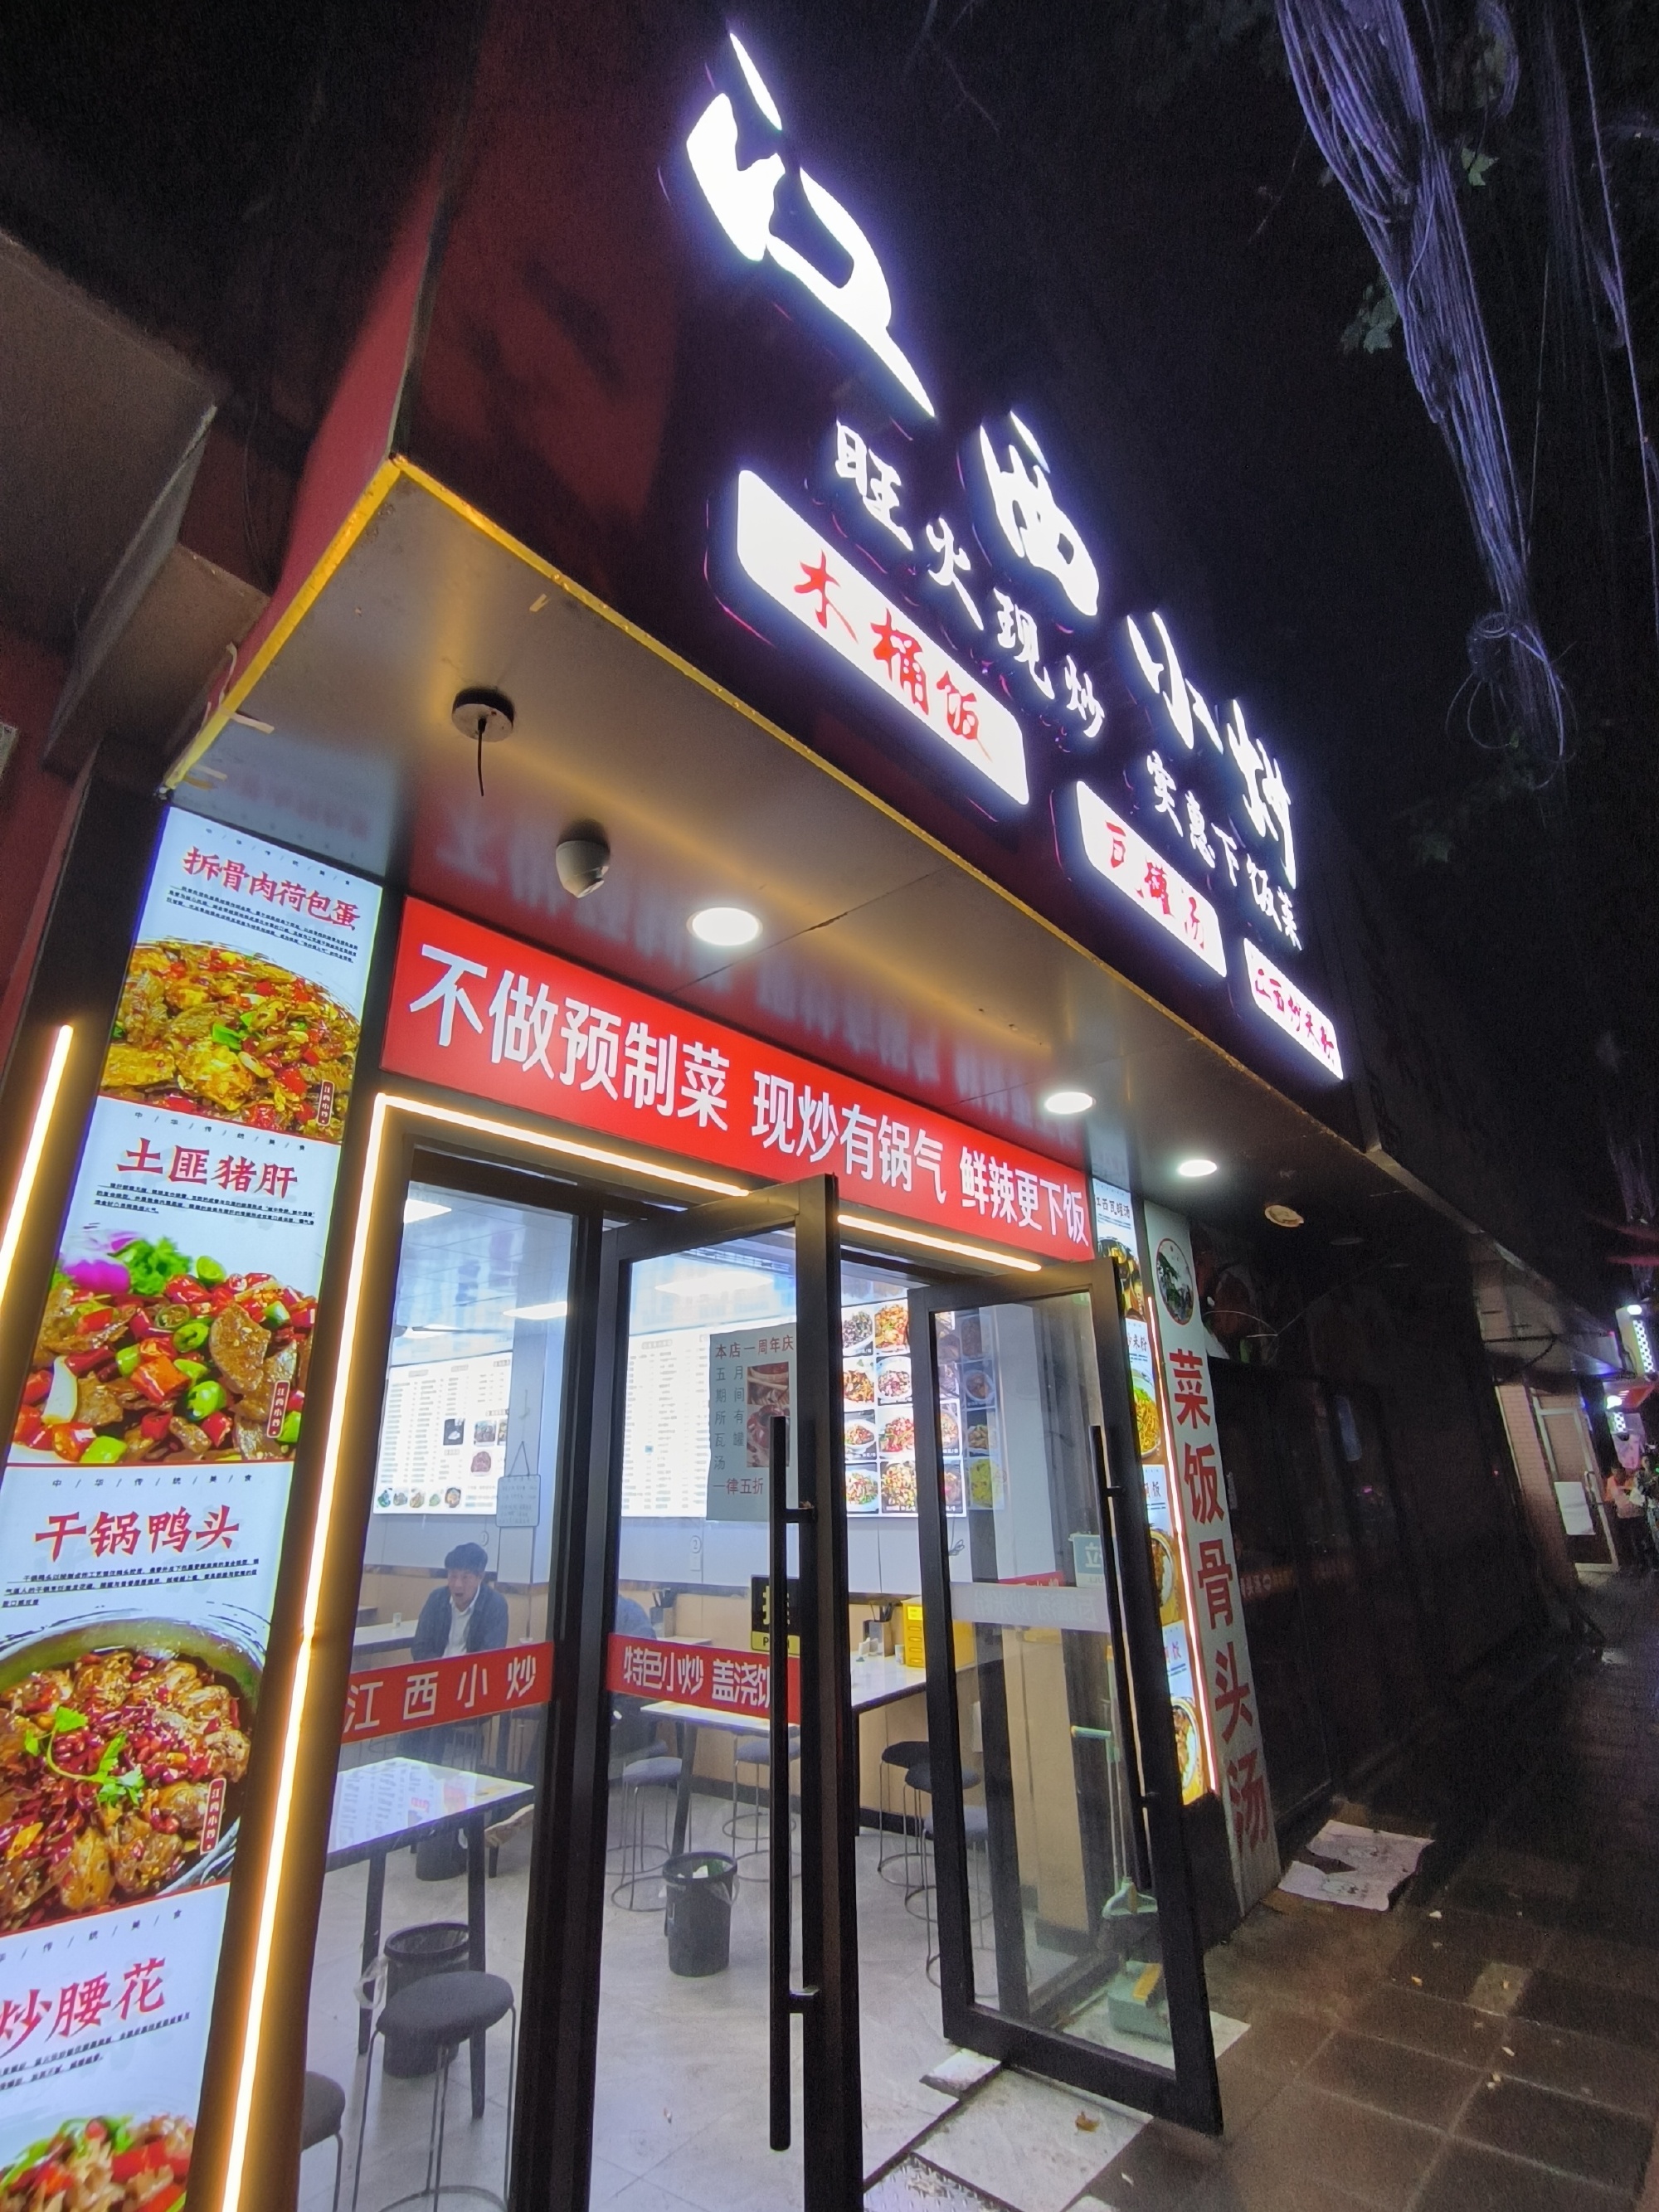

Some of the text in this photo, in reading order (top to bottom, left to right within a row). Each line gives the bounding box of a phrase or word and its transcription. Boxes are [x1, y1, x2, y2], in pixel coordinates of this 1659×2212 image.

[686, 33, 1296, 889] 江西小炒
[834, 420, 1107, 738] 旺火现炒
[794, 550, 993, 762] 木桶饭
[182, 846, 361, 931] 拆骨肉荷包蛋
[1146, 751, 1303, 950] 实惠下饭菜
[410, 944, 1089, 1247] 不做预制菜 现炒有锅气 鲜辣更下饭
[116, 1137, 298, 1199] 土匪猪肝
[715, 1334, 794, 1359] 本店一周年庆
[713, 1478, 763, 1495] 一律五折
[35, 1505, 240, 1563] 干锅鸭头
[343, 1655, 536, 1733] 江西小炒
[624, 1646, 703, 1694] 特色小炒
[0, 1957, 166, 2059] 炒腰花
